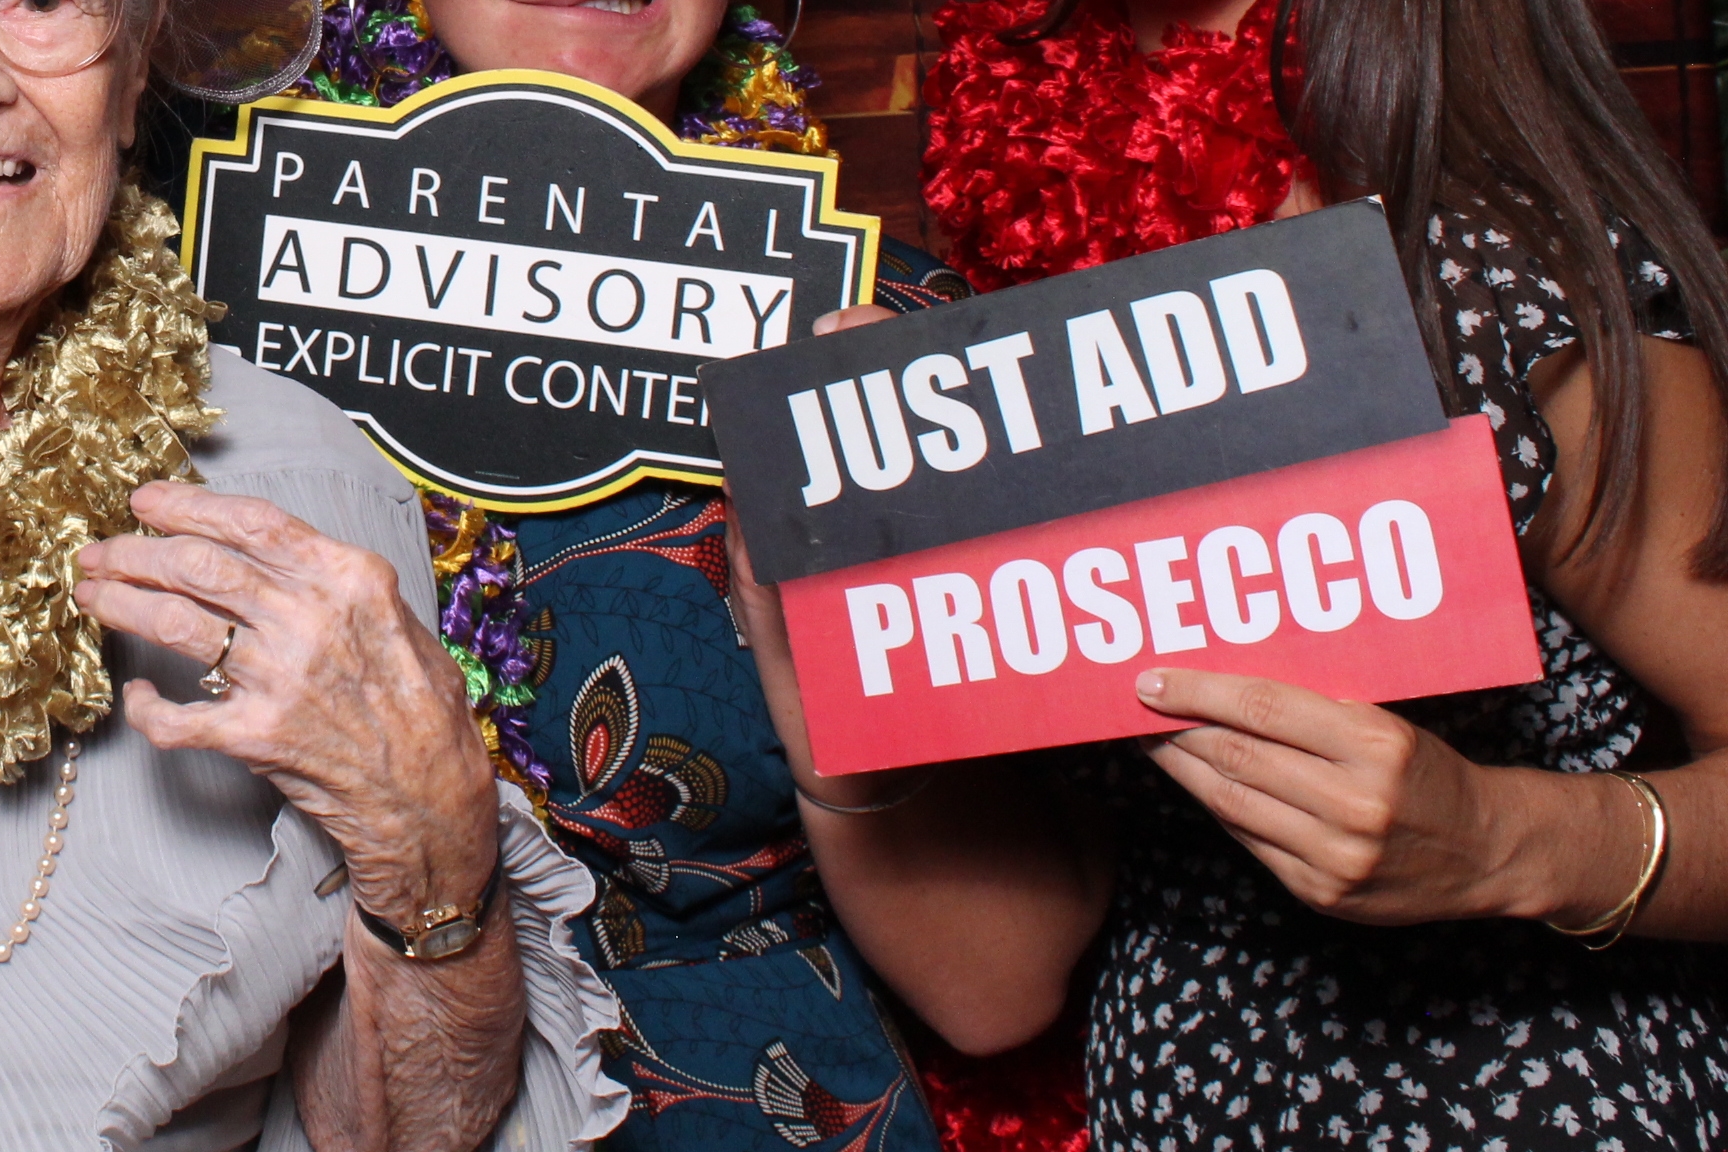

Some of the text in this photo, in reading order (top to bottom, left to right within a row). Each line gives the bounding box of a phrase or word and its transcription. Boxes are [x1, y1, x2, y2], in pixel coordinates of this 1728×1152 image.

[273, 152, 793, 259] PARENTAL
[263, 228, 789, 351] ADVISORY
[256, 322, 709, 427] EXPLICIT CONTE
[787, 267, 1308, 508] JUST ADD
[845, 499, 1445, 697] PROSECCO
